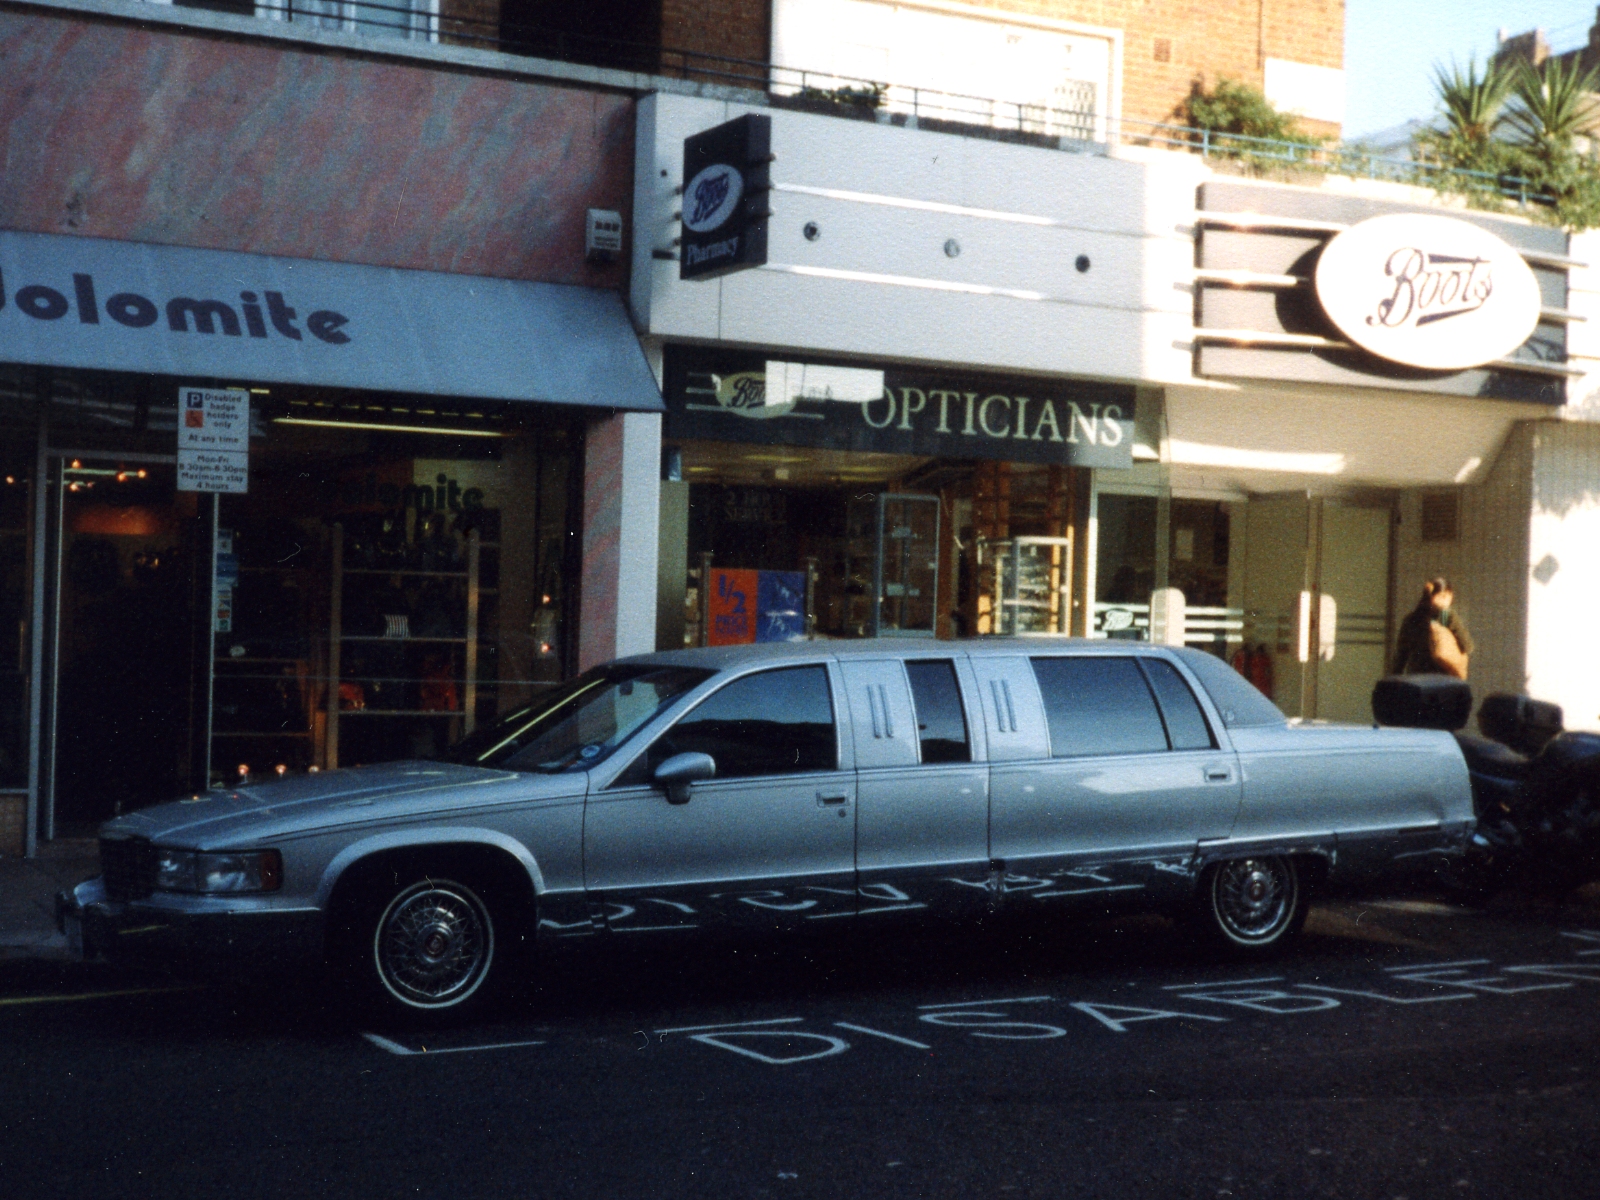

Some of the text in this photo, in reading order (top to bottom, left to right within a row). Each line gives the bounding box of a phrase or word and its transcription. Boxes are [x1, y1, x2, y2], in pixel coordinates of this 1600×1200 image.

[1365, 246, 1493, 328] Boots
[0, 266, 351, 345] olomite
[204, 393, 241, 402] Disabled
[210, 403, 236, 411] badge
[207, 411, 239, 420] holders
[861, 384, 1122, 447] OPTICIANS
[213, 420, 231, 428] only
[181, 472, 243, 483] Maximum stay
[205, 482, 229, 490] hours
